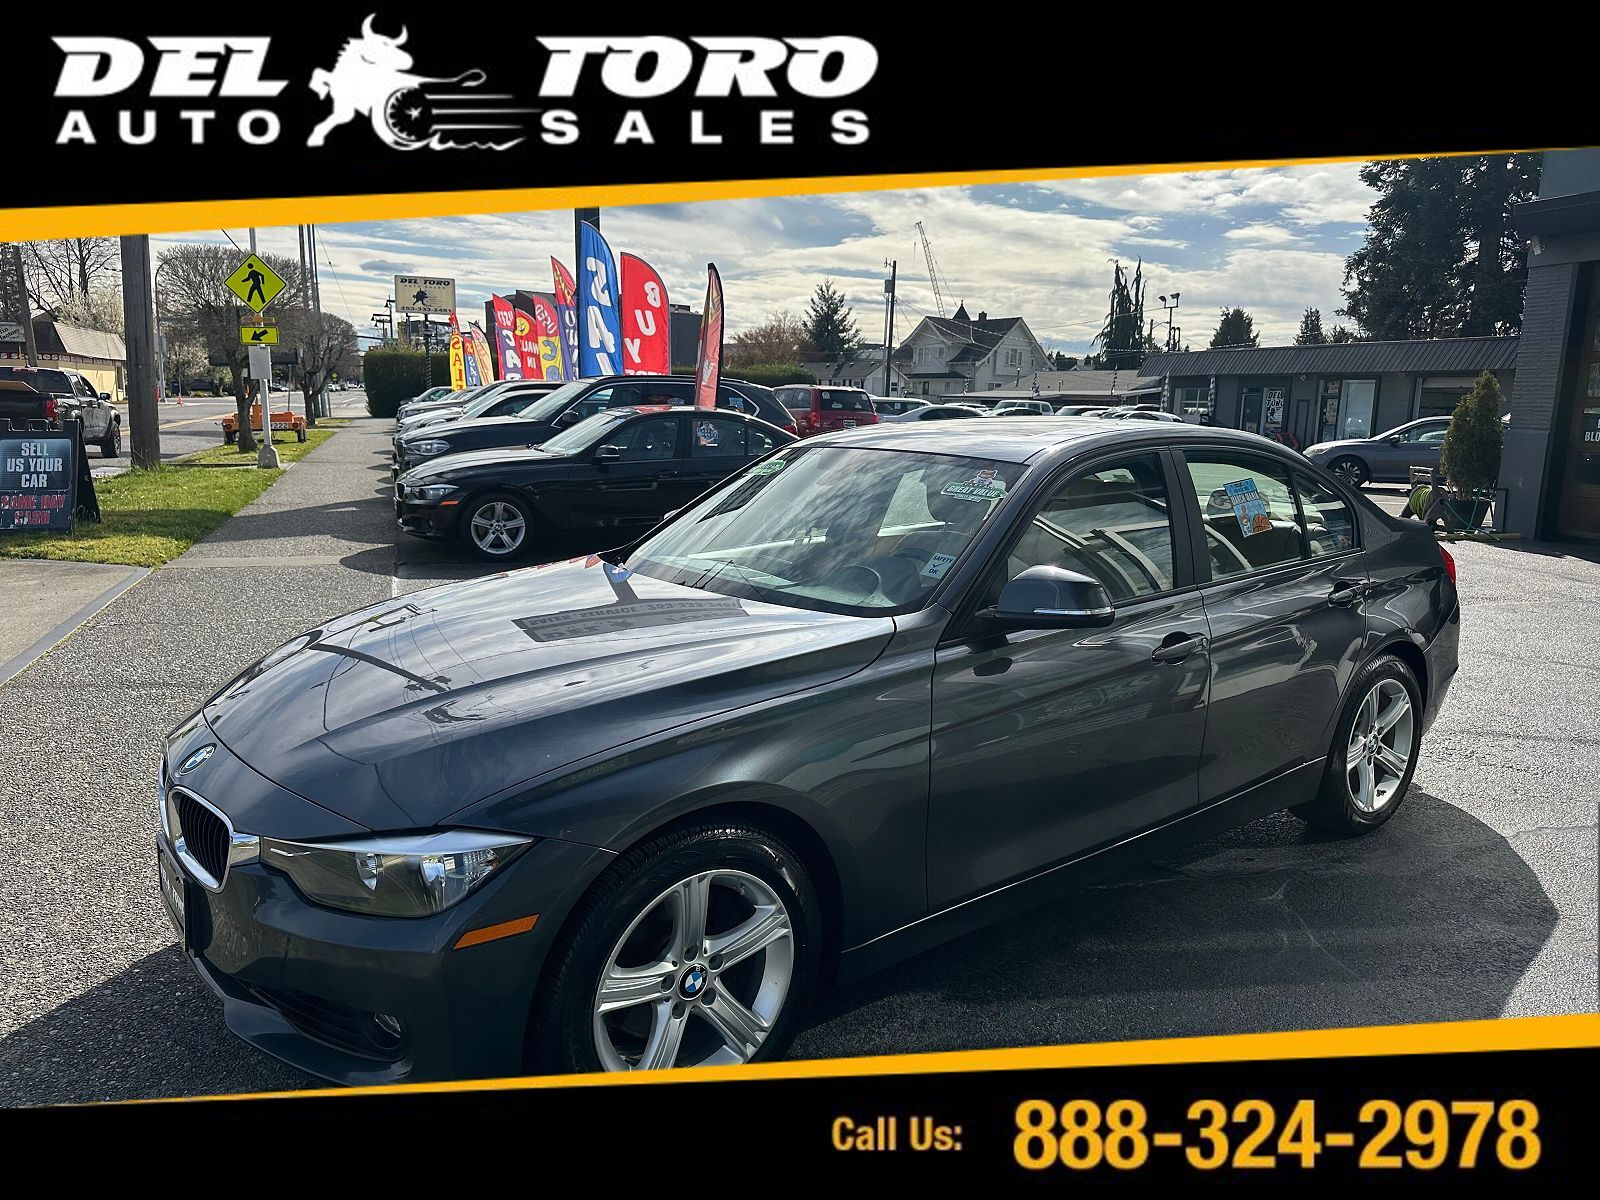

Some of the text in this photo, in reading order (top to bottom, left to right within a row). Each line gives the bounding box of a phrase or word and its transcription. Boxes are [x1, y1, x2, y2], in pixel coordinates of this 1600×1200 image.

[21, 442, 49, 456] SELL
[7, 458, 63, 472] US YOUR
[21, 474, 48, 488] CAR
[946, 485, 973, 494] GREAT
[973, 487, 999, 498] VALUE
[41, 494, 65, 509] DAY
[932, 555, 953, 563] SAFETY
